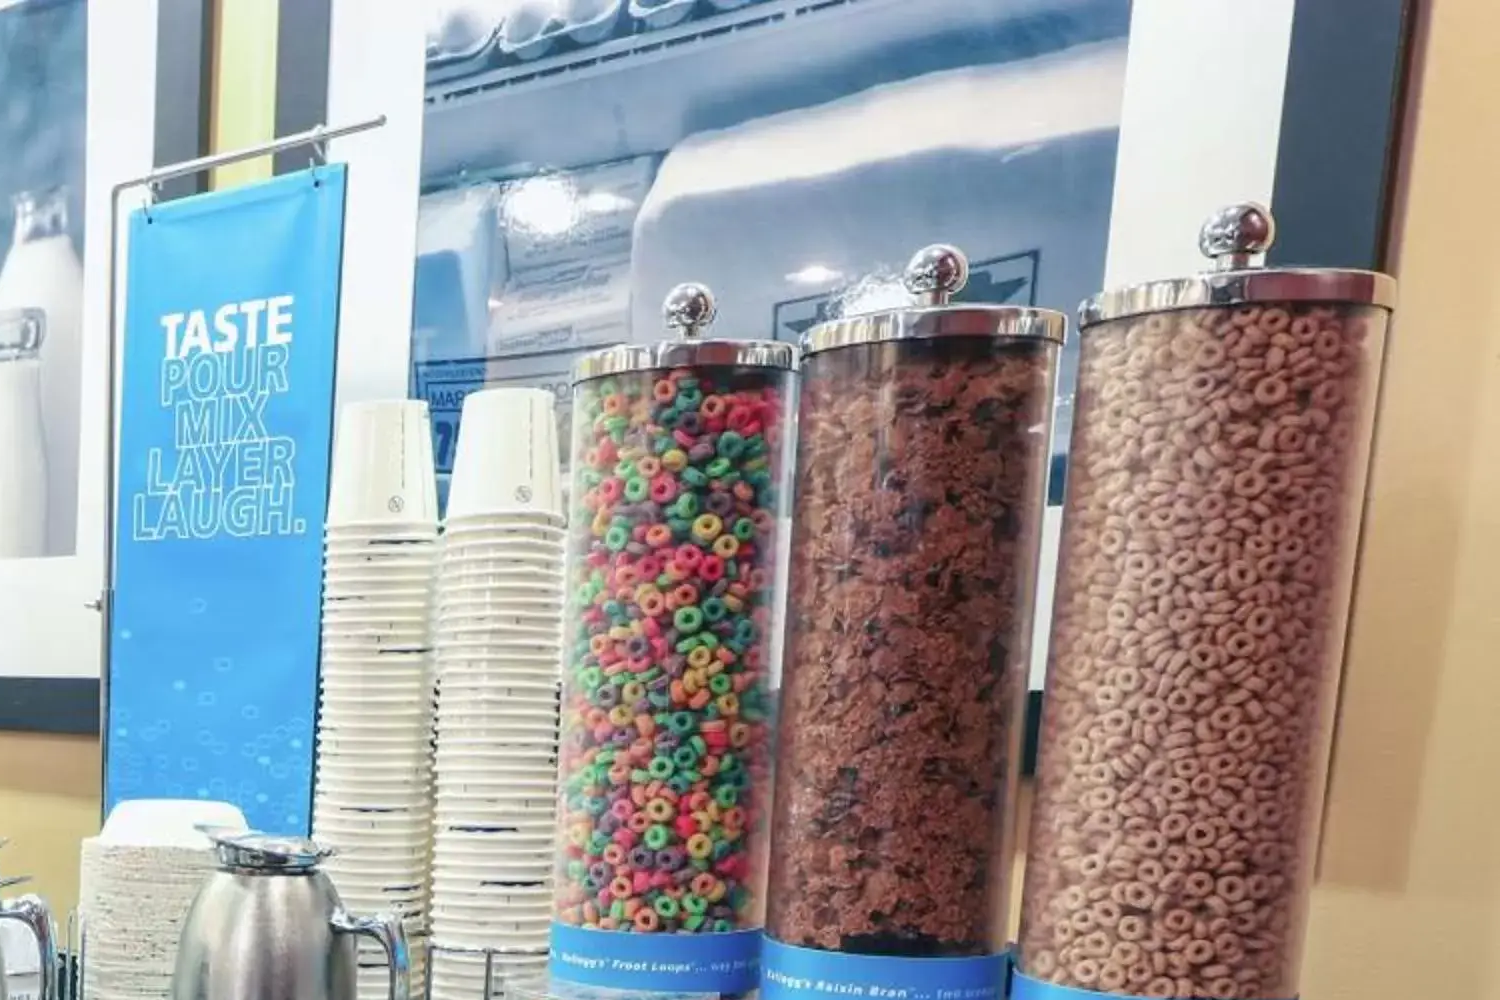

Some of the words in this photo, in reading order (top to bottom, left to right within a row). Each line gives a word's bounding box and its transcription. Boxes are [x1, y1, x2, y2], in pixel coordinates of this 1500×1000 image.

[160, 295, 294, 360] TASTE
[161, 344, 288, 407] POUR
[174, 391, 269, 448] MIX
[147, 437, 295, 496] LAYER
[133, 482, 306, 541] LAUGH.
[611, 958, 648, 972] Froot
[815, 980, 864, 996] Raisin
